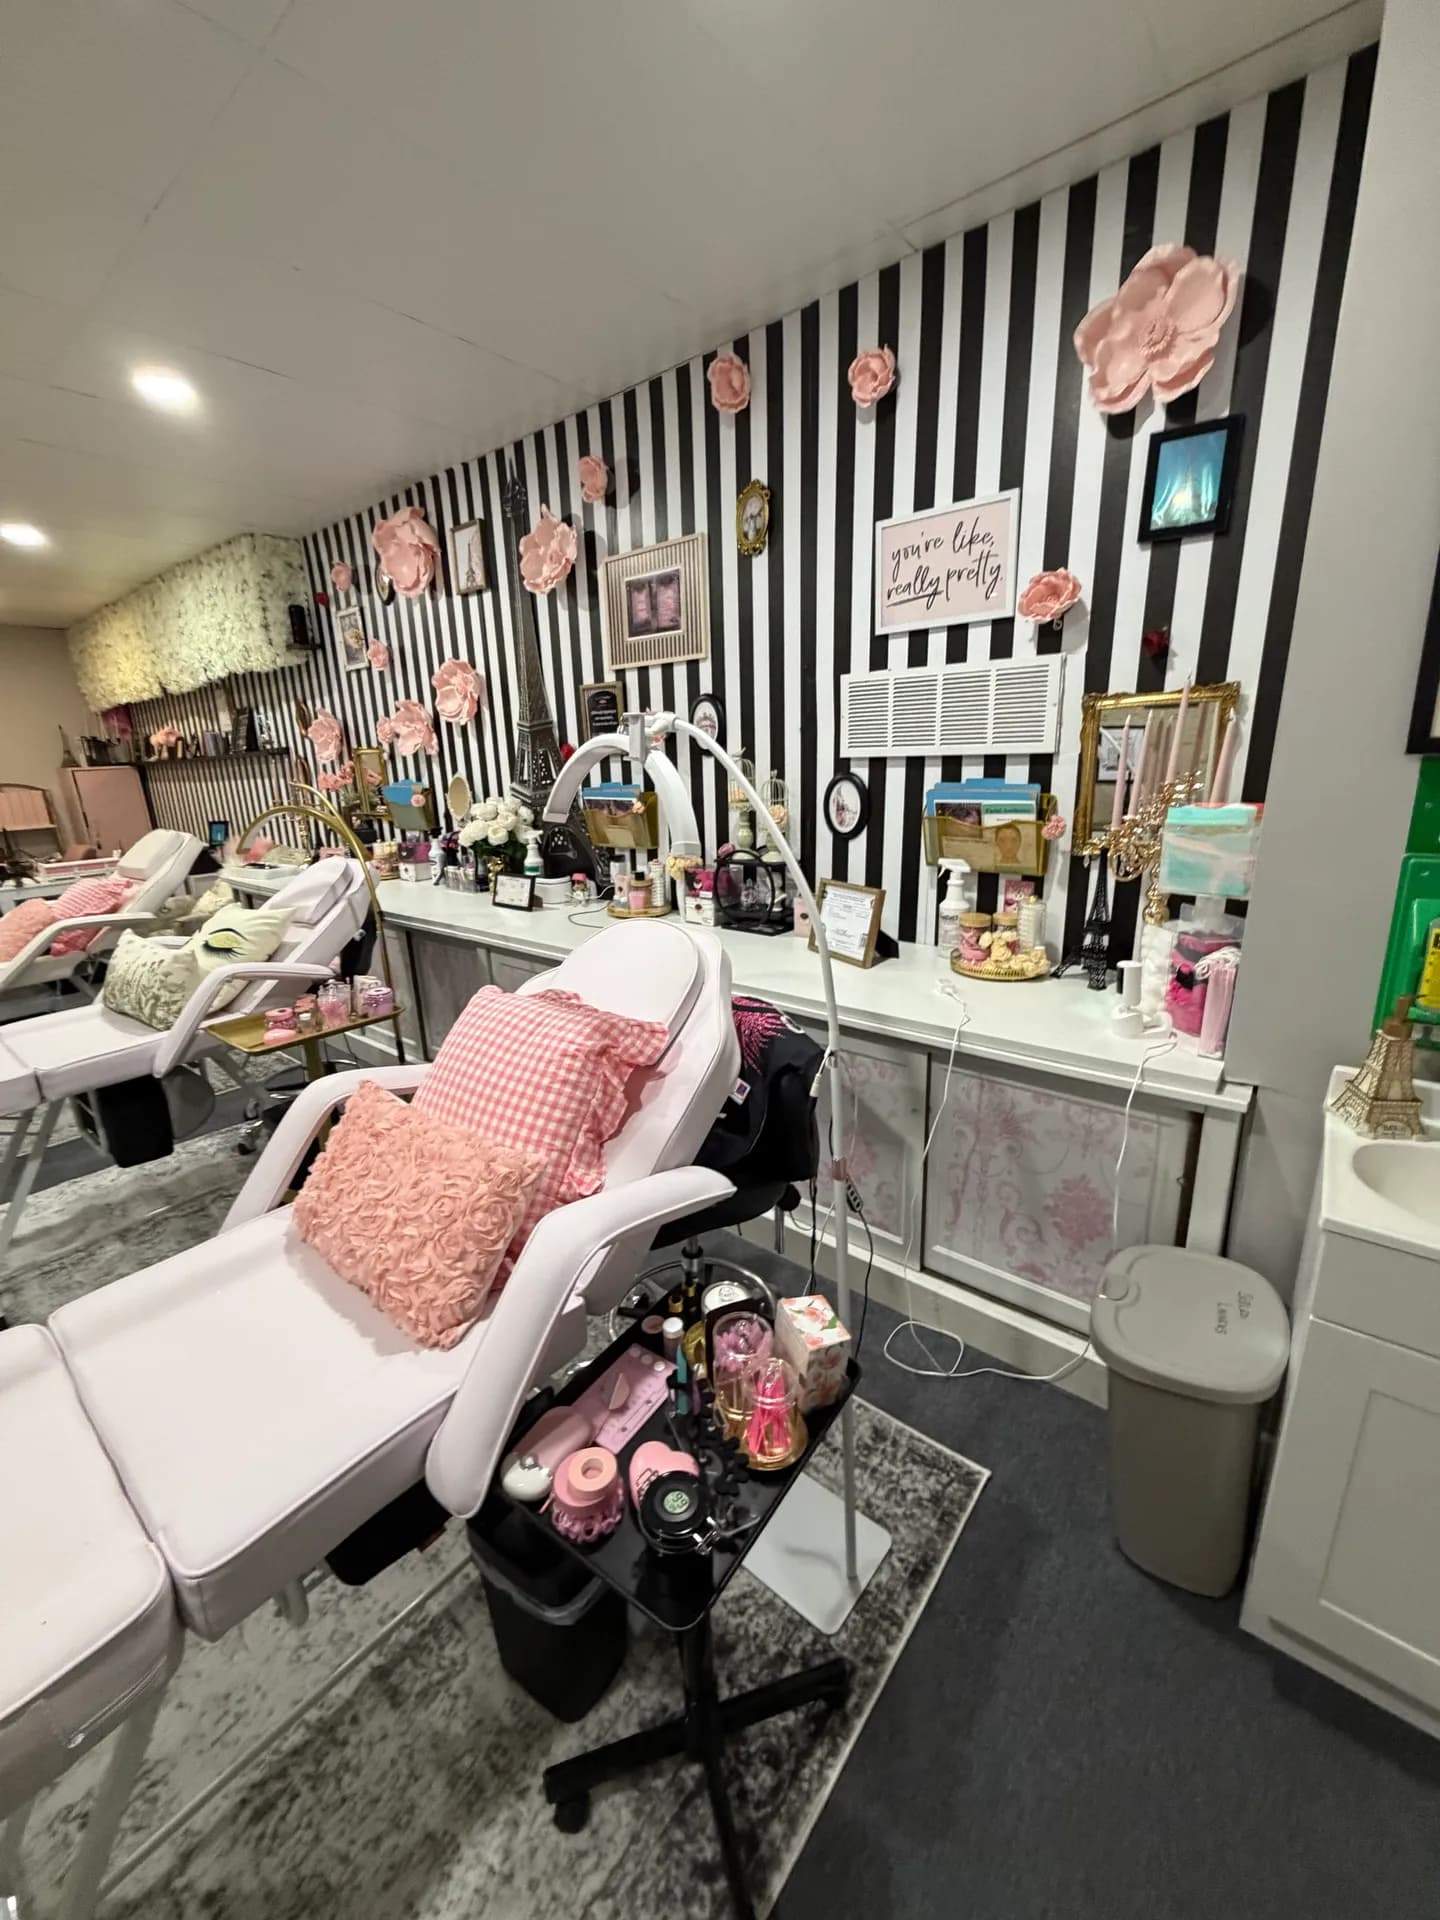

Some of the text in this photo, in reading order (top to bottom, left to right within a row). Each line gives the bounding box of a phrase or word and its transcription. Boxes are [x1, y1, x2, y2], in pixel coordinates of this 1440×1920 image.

[887, 549, 1003, 610] really pretty.
[892, 516, 995, 582] you're like,
